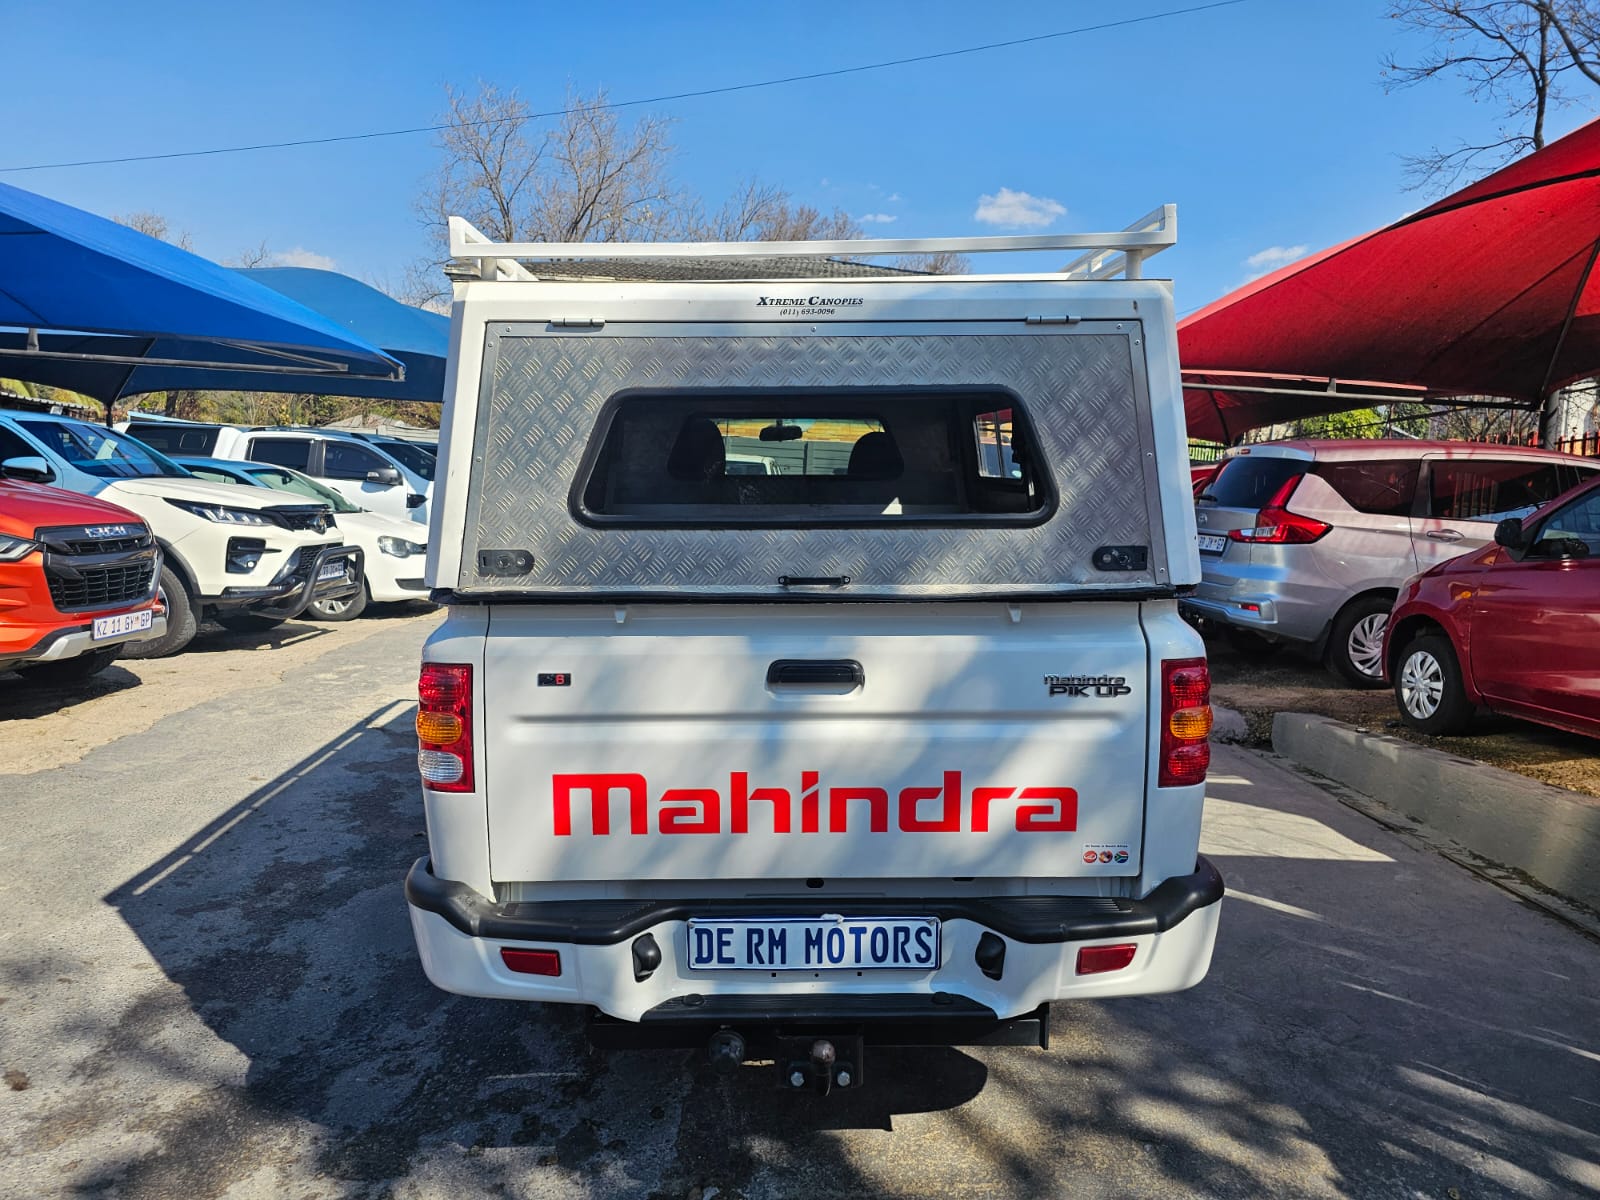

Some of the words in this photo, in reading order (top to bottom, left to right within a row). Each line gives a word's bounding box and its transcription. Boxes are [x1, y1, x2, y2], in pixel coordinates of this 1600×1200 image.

[756, 297, 806, 306] XTREME
[808, 297, 864, 306] CANOPIES
[780, 308, 799, 316] (011)
[140, 612, 150, 627] GP
[1049, 685, 1090, 698] PIK
[1095, 685, 1132, 698] UP
[695, 928, 735, 964] DE
[746, 927, 787, 964] RM
[805, 926, 933, 964] MOTORS
